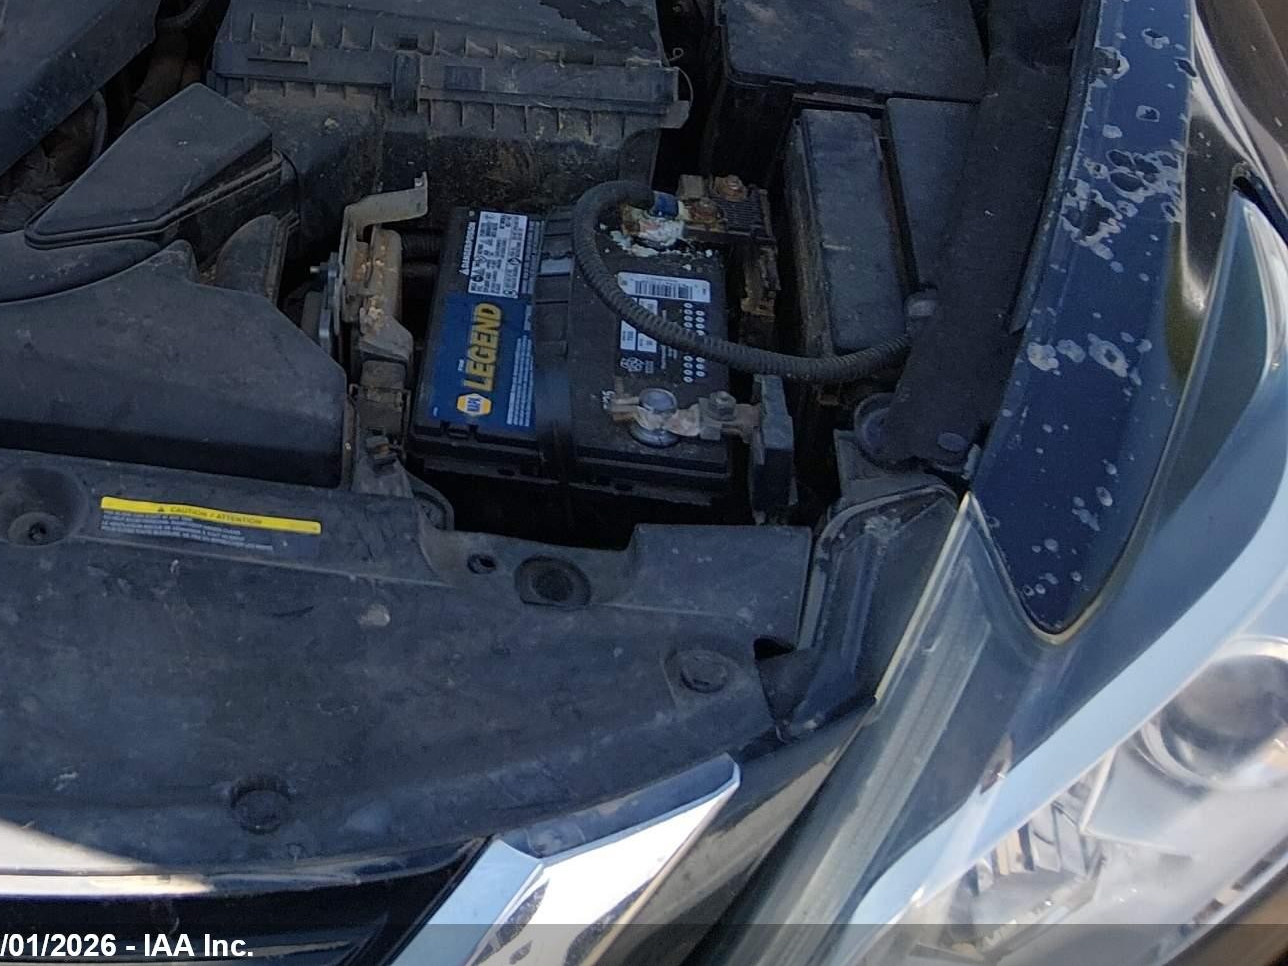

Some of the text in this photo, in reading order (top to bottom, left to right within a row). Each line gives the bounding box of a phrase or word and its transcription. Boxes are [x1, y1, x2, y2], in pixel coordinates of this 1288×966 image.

[463, 303, 502, 392] LEGEND
[467, 396, 481, 413] NAPA
[170, 505, 209, 517] CAUTION
[216, 513, 263, 525] ATTENTION
